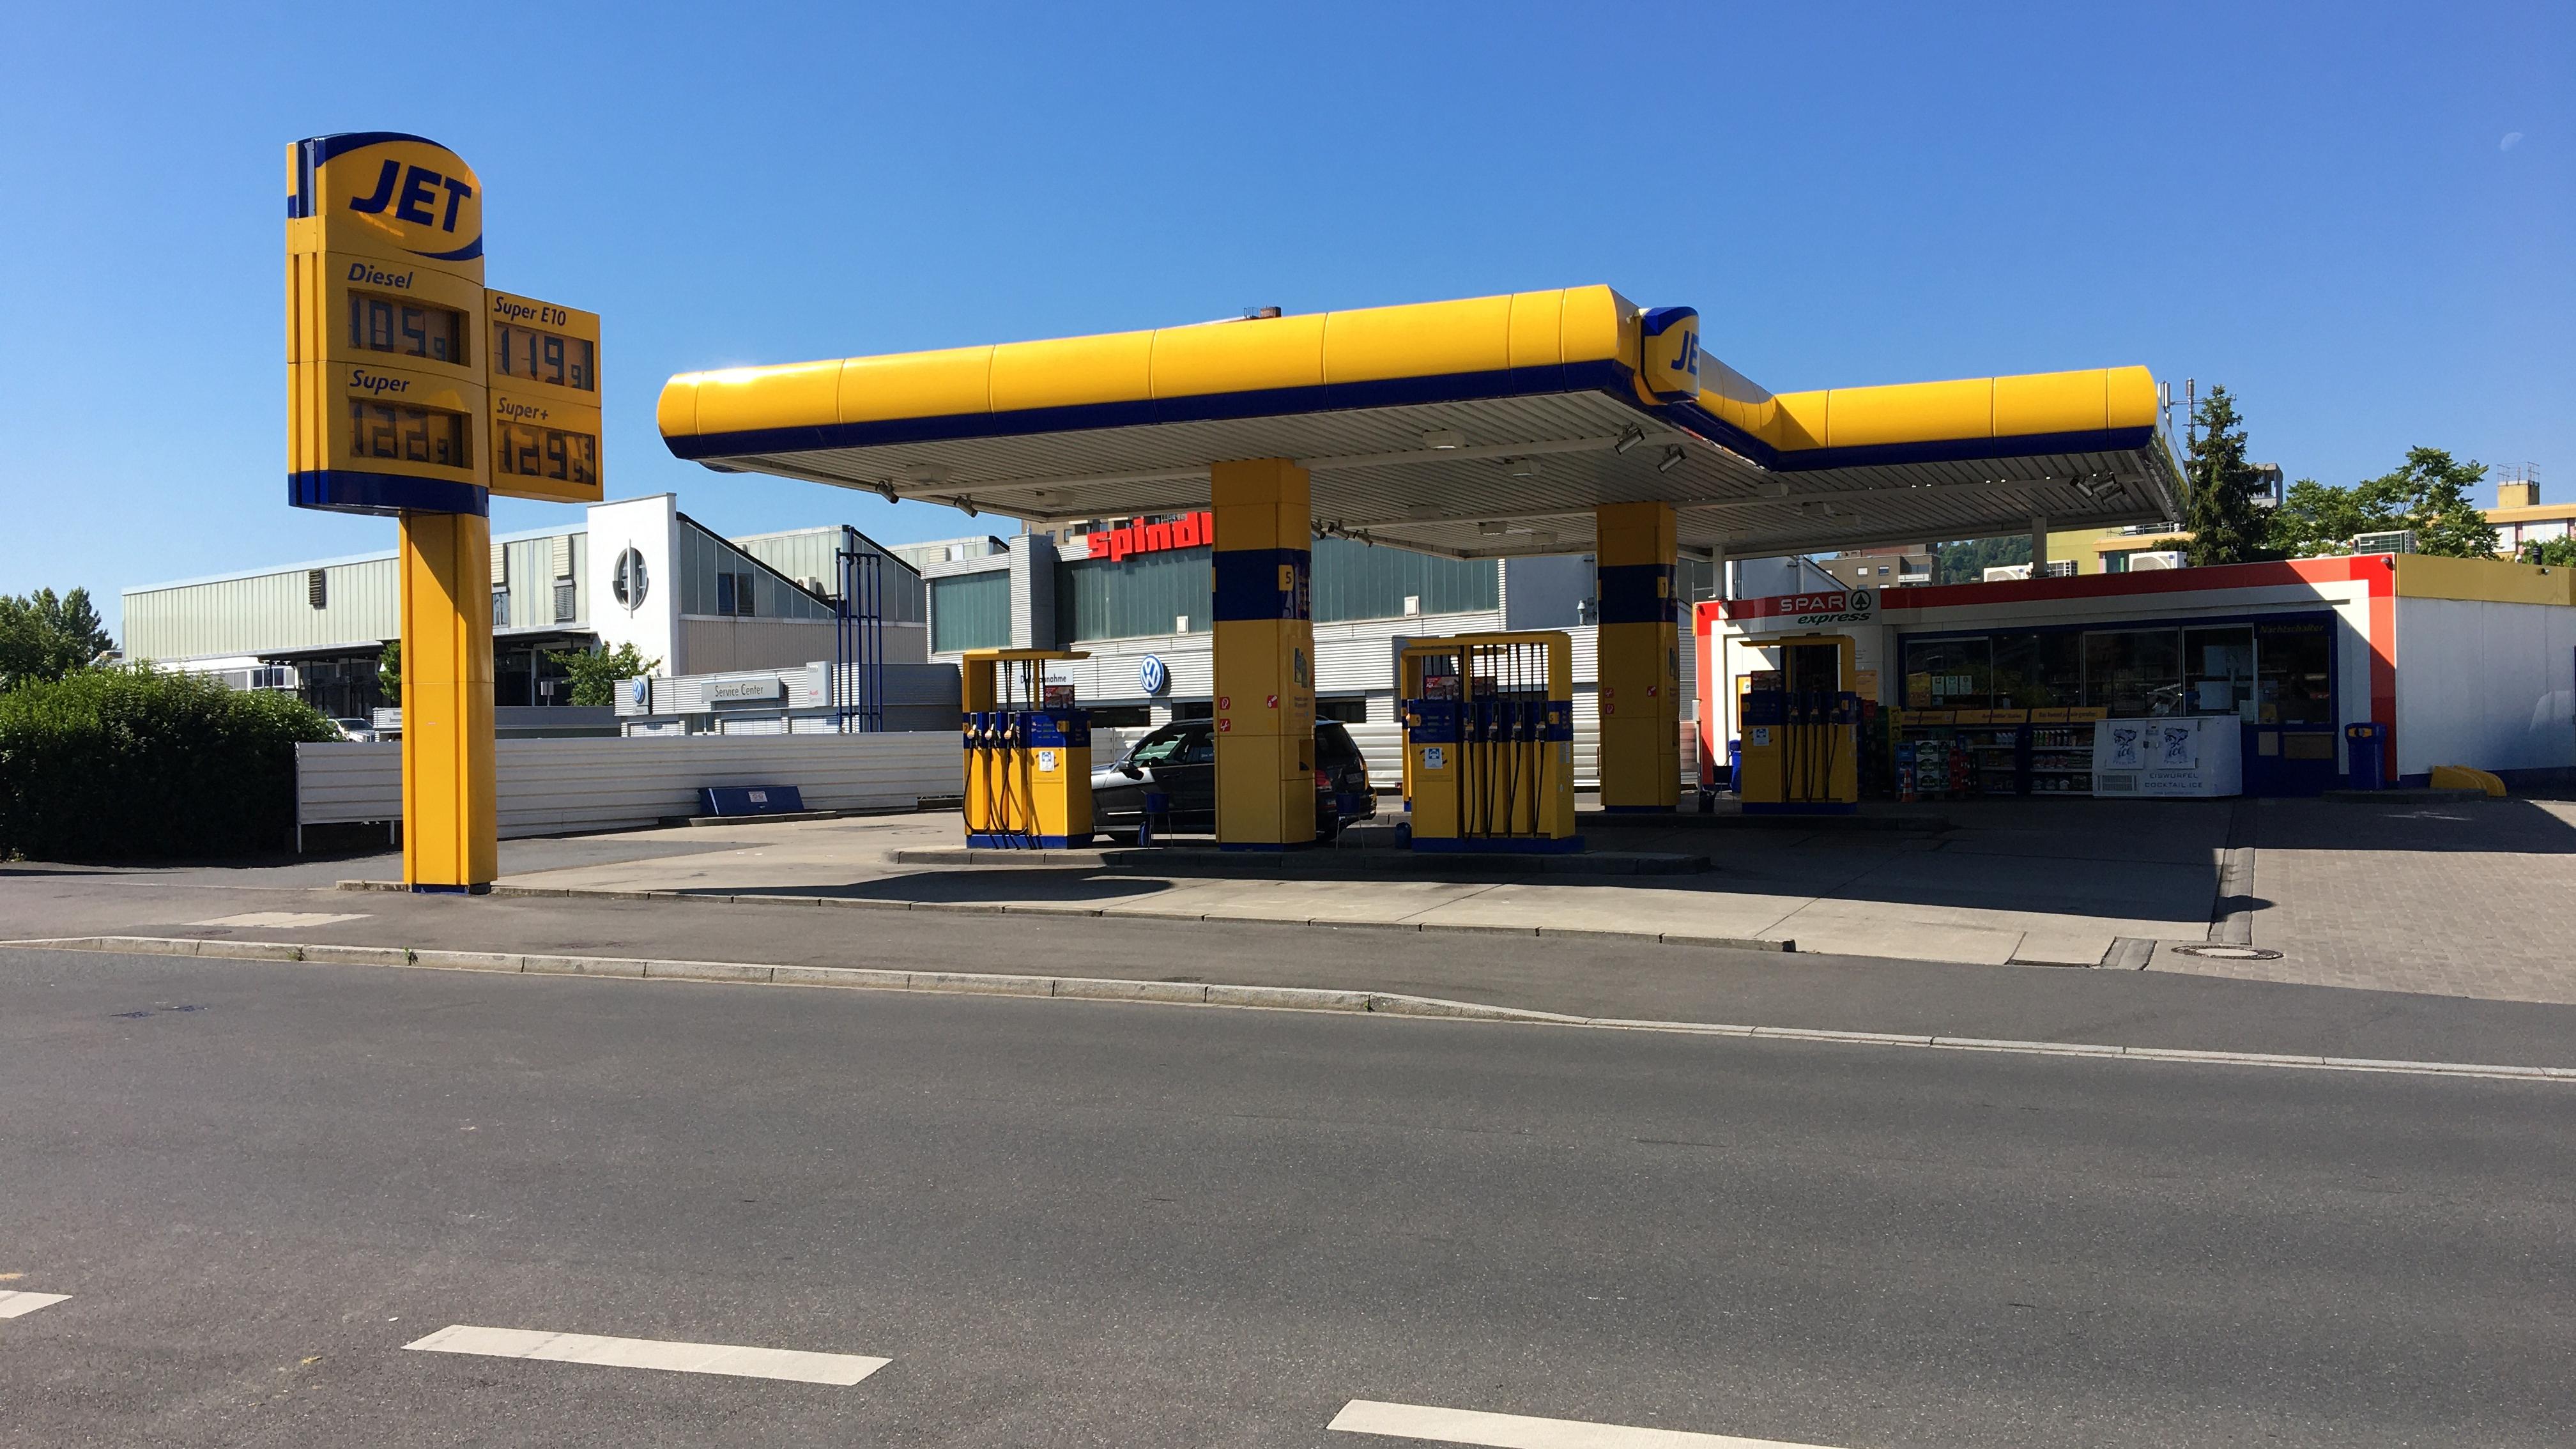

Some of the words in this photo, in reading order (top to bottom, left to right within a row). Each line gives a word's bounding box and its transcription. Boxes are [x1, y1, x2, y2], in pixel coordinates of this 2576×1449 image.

[349, 159, 472, 233] JET
[348, 263, 413, 289] Diesel
[494, 296, 537, 321] Super
[540, 307, 566, 326] E10
[349, 369, 410, 395] Super
[496, 397, 548, 421] Super+
[1285, 571, 1292, 584] 5
[1781, 595, 1844, 612] SPAR
[1798, 612, 1871, 625] express
[715, 685, 739, 697] Service
[740, 684, 763, 695] Center
